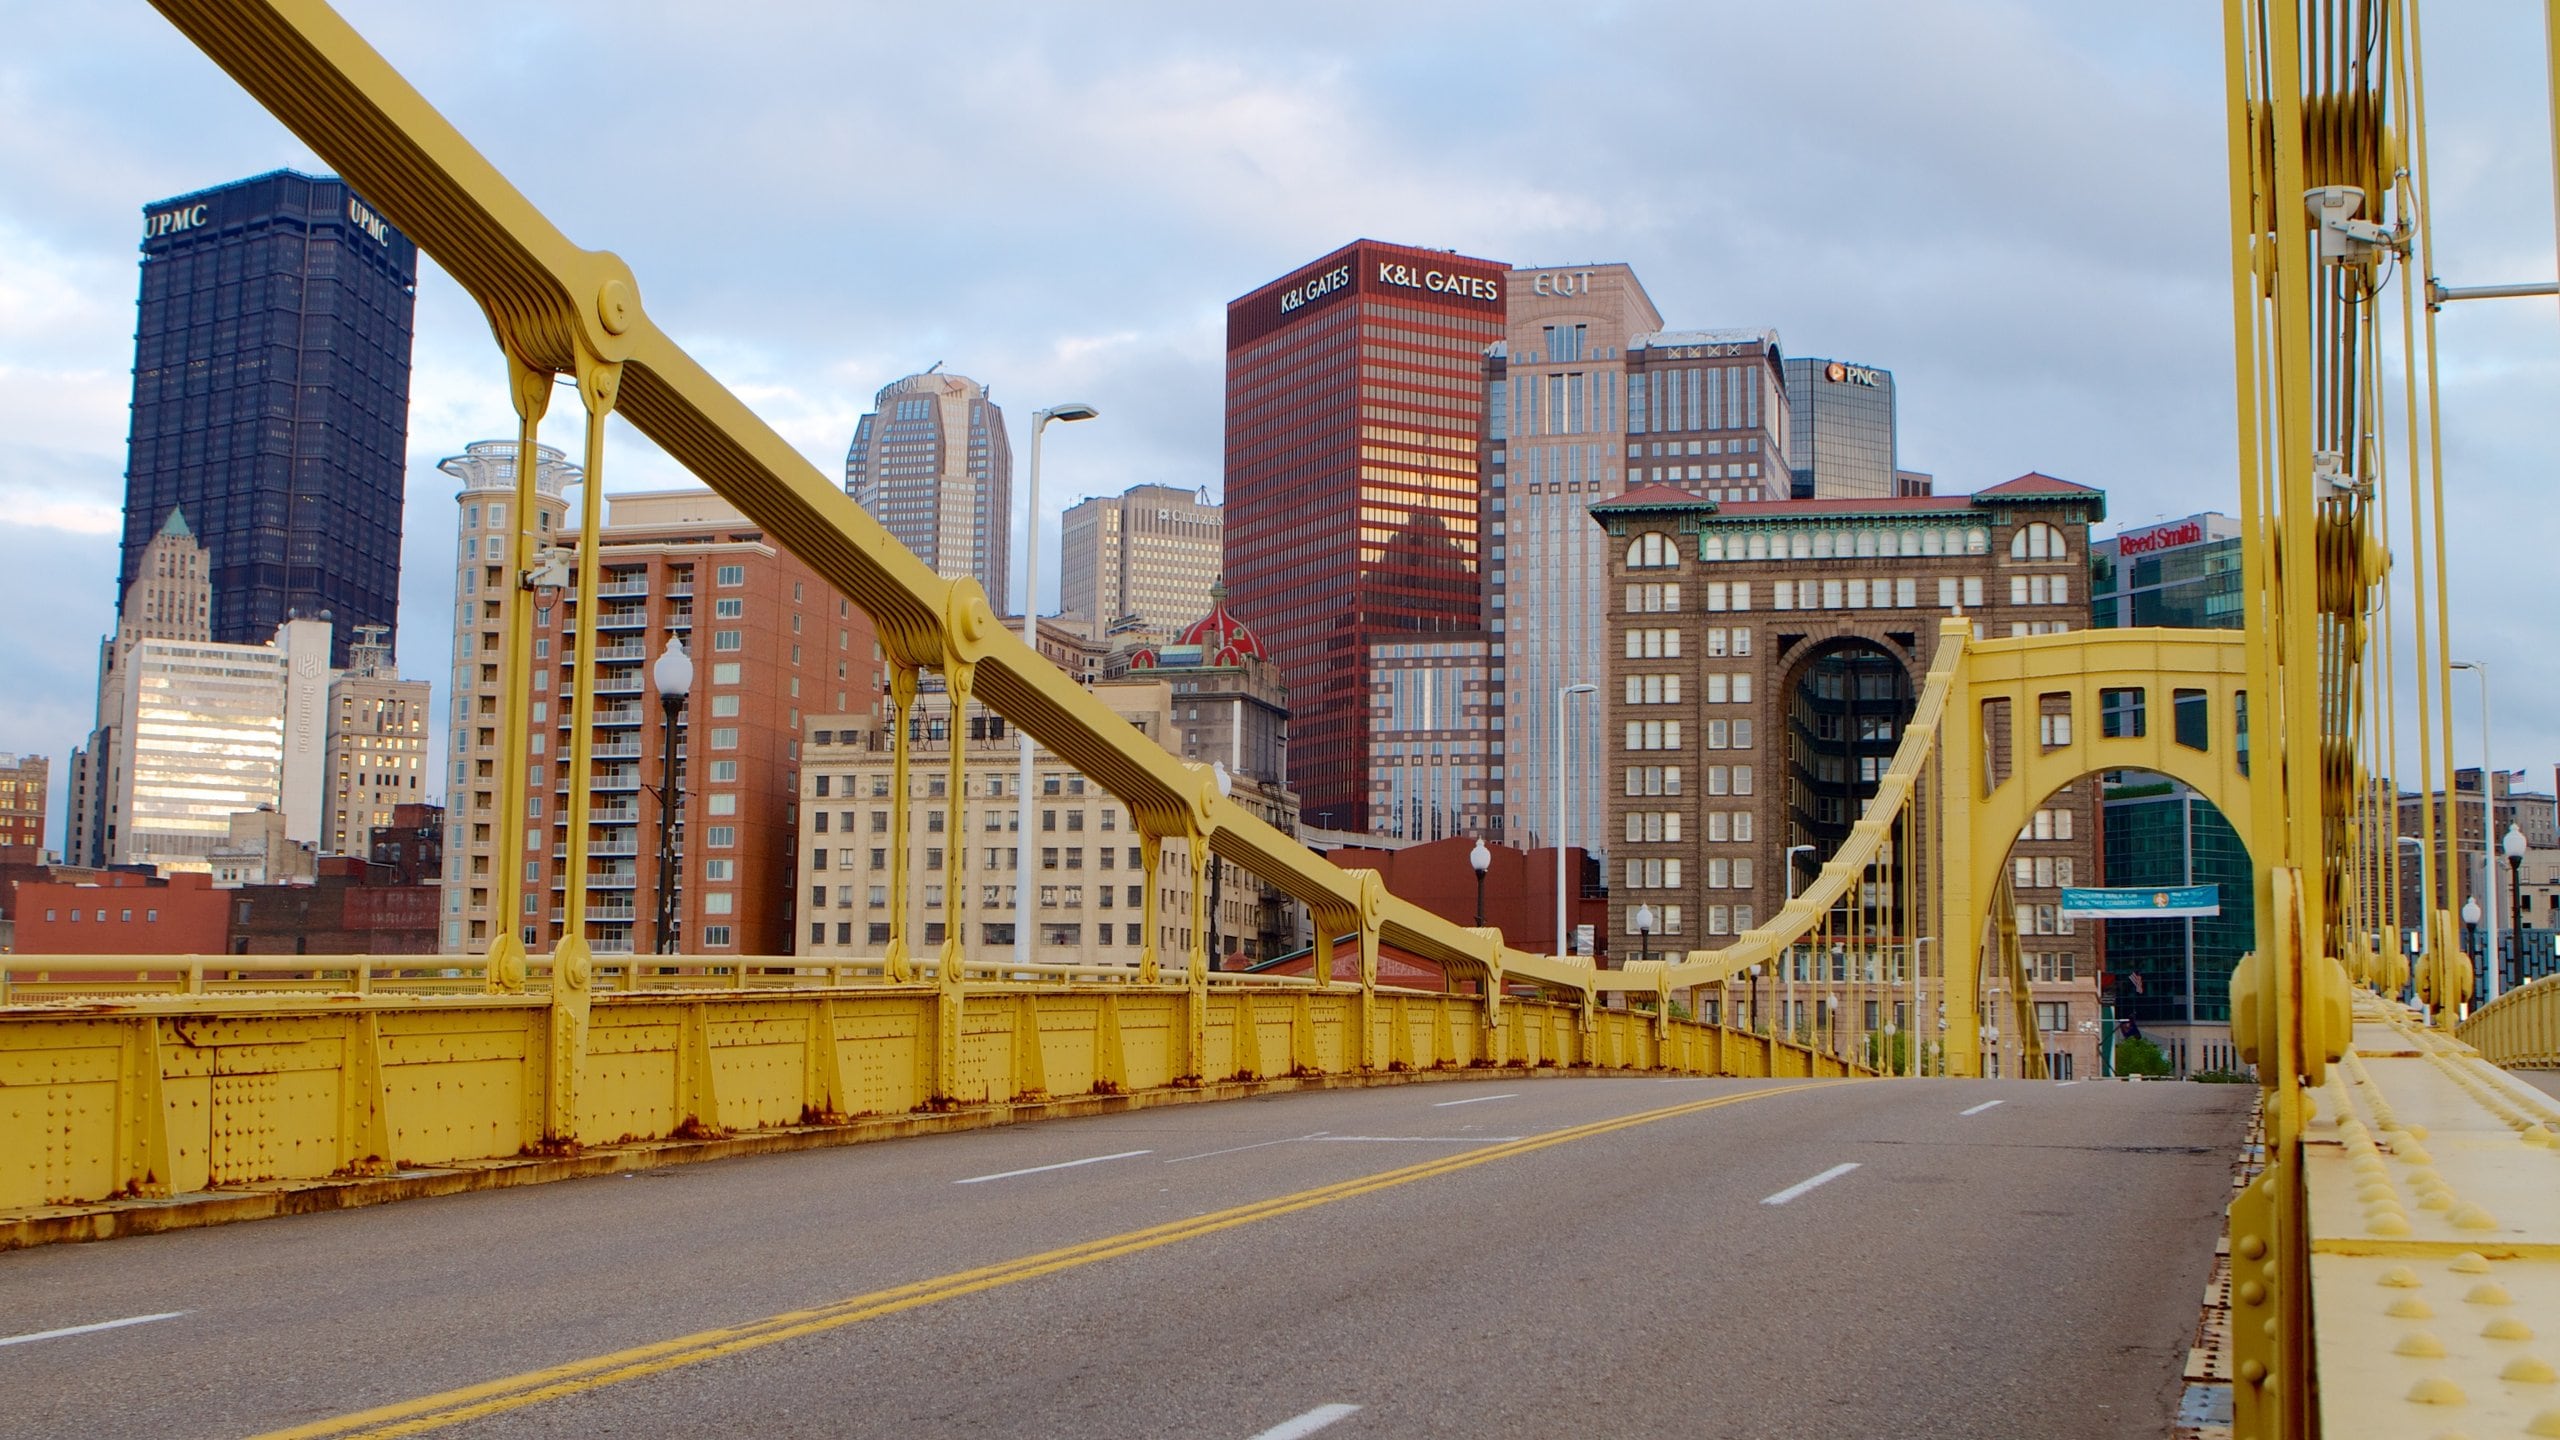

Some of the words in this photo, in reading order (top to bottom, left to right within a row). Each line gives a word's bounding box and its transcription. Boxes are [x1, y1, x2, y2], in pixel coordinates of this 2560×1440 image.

[144, 204, 207, 238] UPMC
[349, 198, 389, 248] UPMC
[1281, 290, 1305, 314] K&L
[1306, 265, 1350, 303] GATES
[1379, 262, 1421, 289] K&L
[1425, 270, 1498, 301] GATES
[1533, 270, 1595, 298] EQT
[1846, 365, 1880, 387] PNC
[2120, 530, 2157, 556] Reed
[2157, 522, 2201, 549] Smith
[298, 685, 315, 752] Huntington
